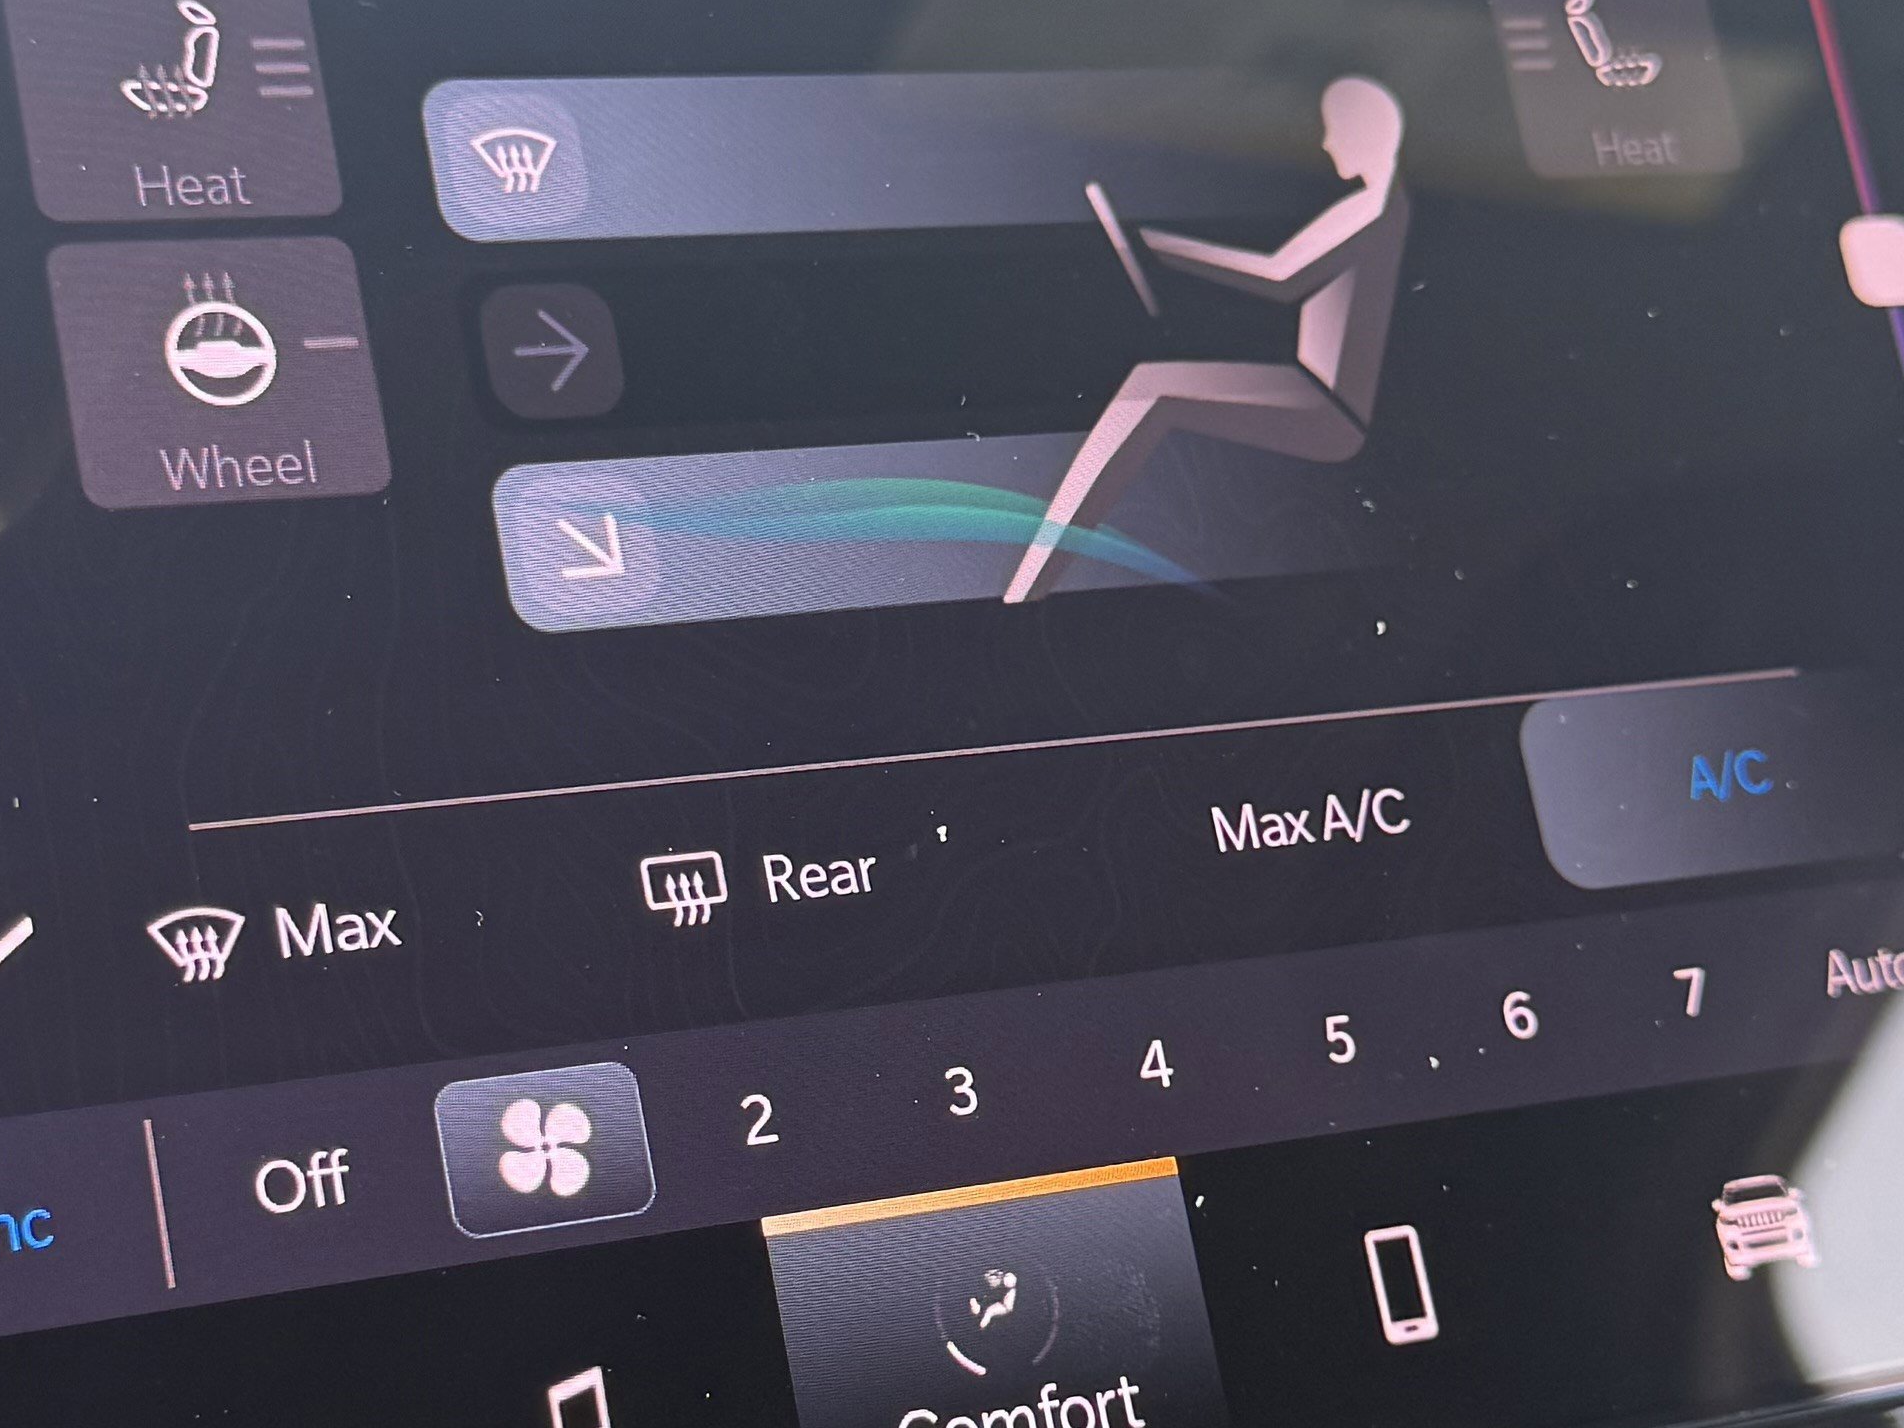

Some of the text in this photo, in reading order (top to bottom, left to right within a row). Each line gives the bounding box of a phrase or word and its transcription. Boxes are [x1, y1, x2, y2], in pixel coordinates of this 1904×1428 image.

[1591, 128, 1678, 167] Heat
[134, 164, 252, 208] Heat
[159, 439, 318, 492] Wheel
[1688, 747, 1776, 804] A/C
[1211, 787, 1412, 853] Max A/C
[761, 847, 878, 907] Rear
[273, 902, 403, 962] Max
[1500, 990, 1541, 1042] 6
[1672, 966, 1709, 1019] 7
[1136, 1038, 1177, 1091] 4
[1323, 1014, 1359, 1066] 5
[940, 1065, 982, 1120] 3
[738, 1092, 782, 1149] 2
[253, 1146, 352, 1217] Off
